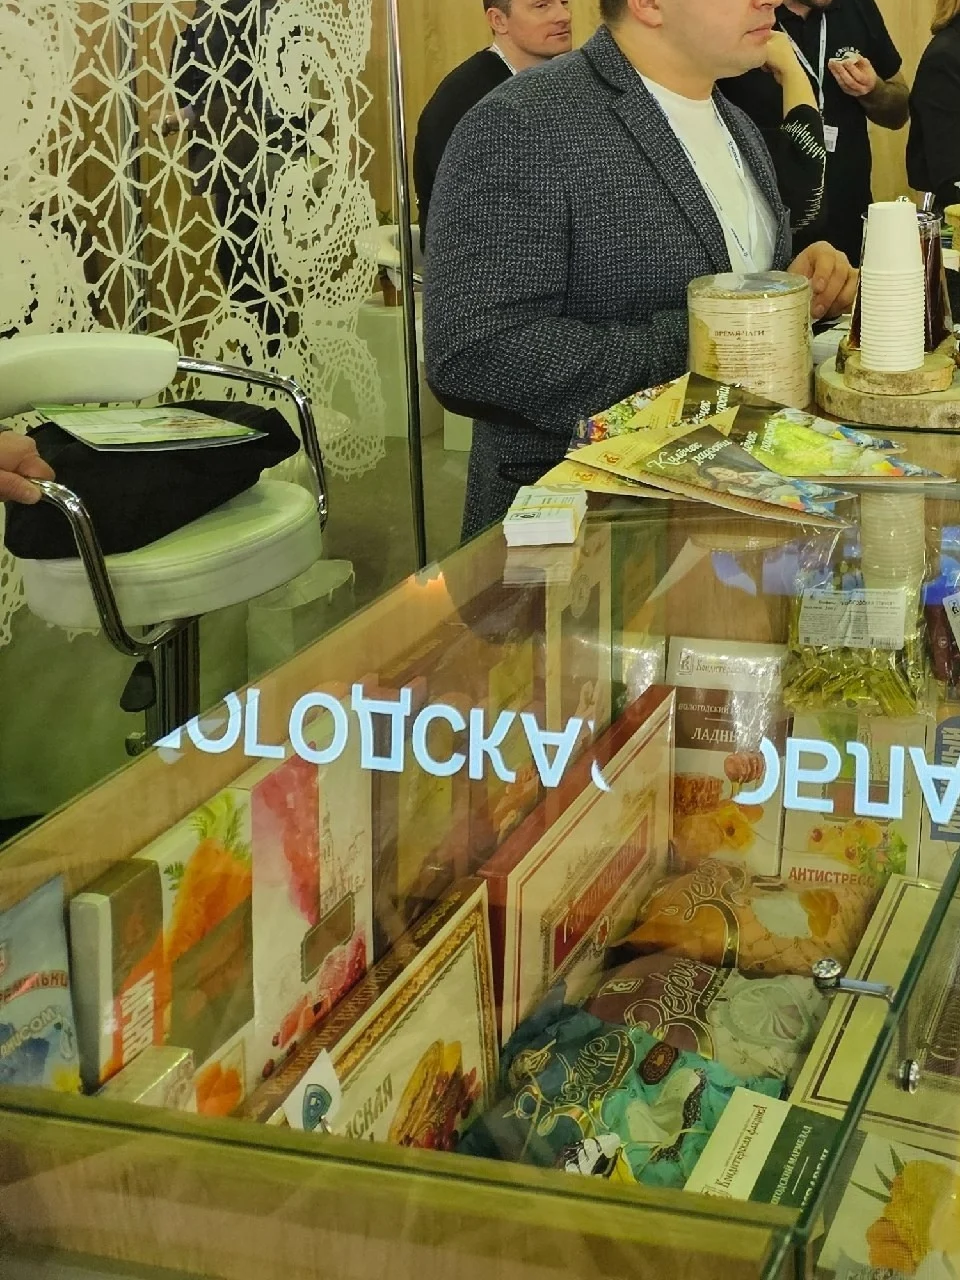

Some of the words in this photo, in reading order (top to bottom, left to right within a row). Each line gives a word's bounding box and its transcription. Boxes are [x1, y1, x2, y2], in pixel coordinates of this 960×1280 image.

[646, 442, 702, 469] Кулёчек
[692, 439, 733, 466] радости
[789, 866, 876, 889] АНТИСТРЕСС
